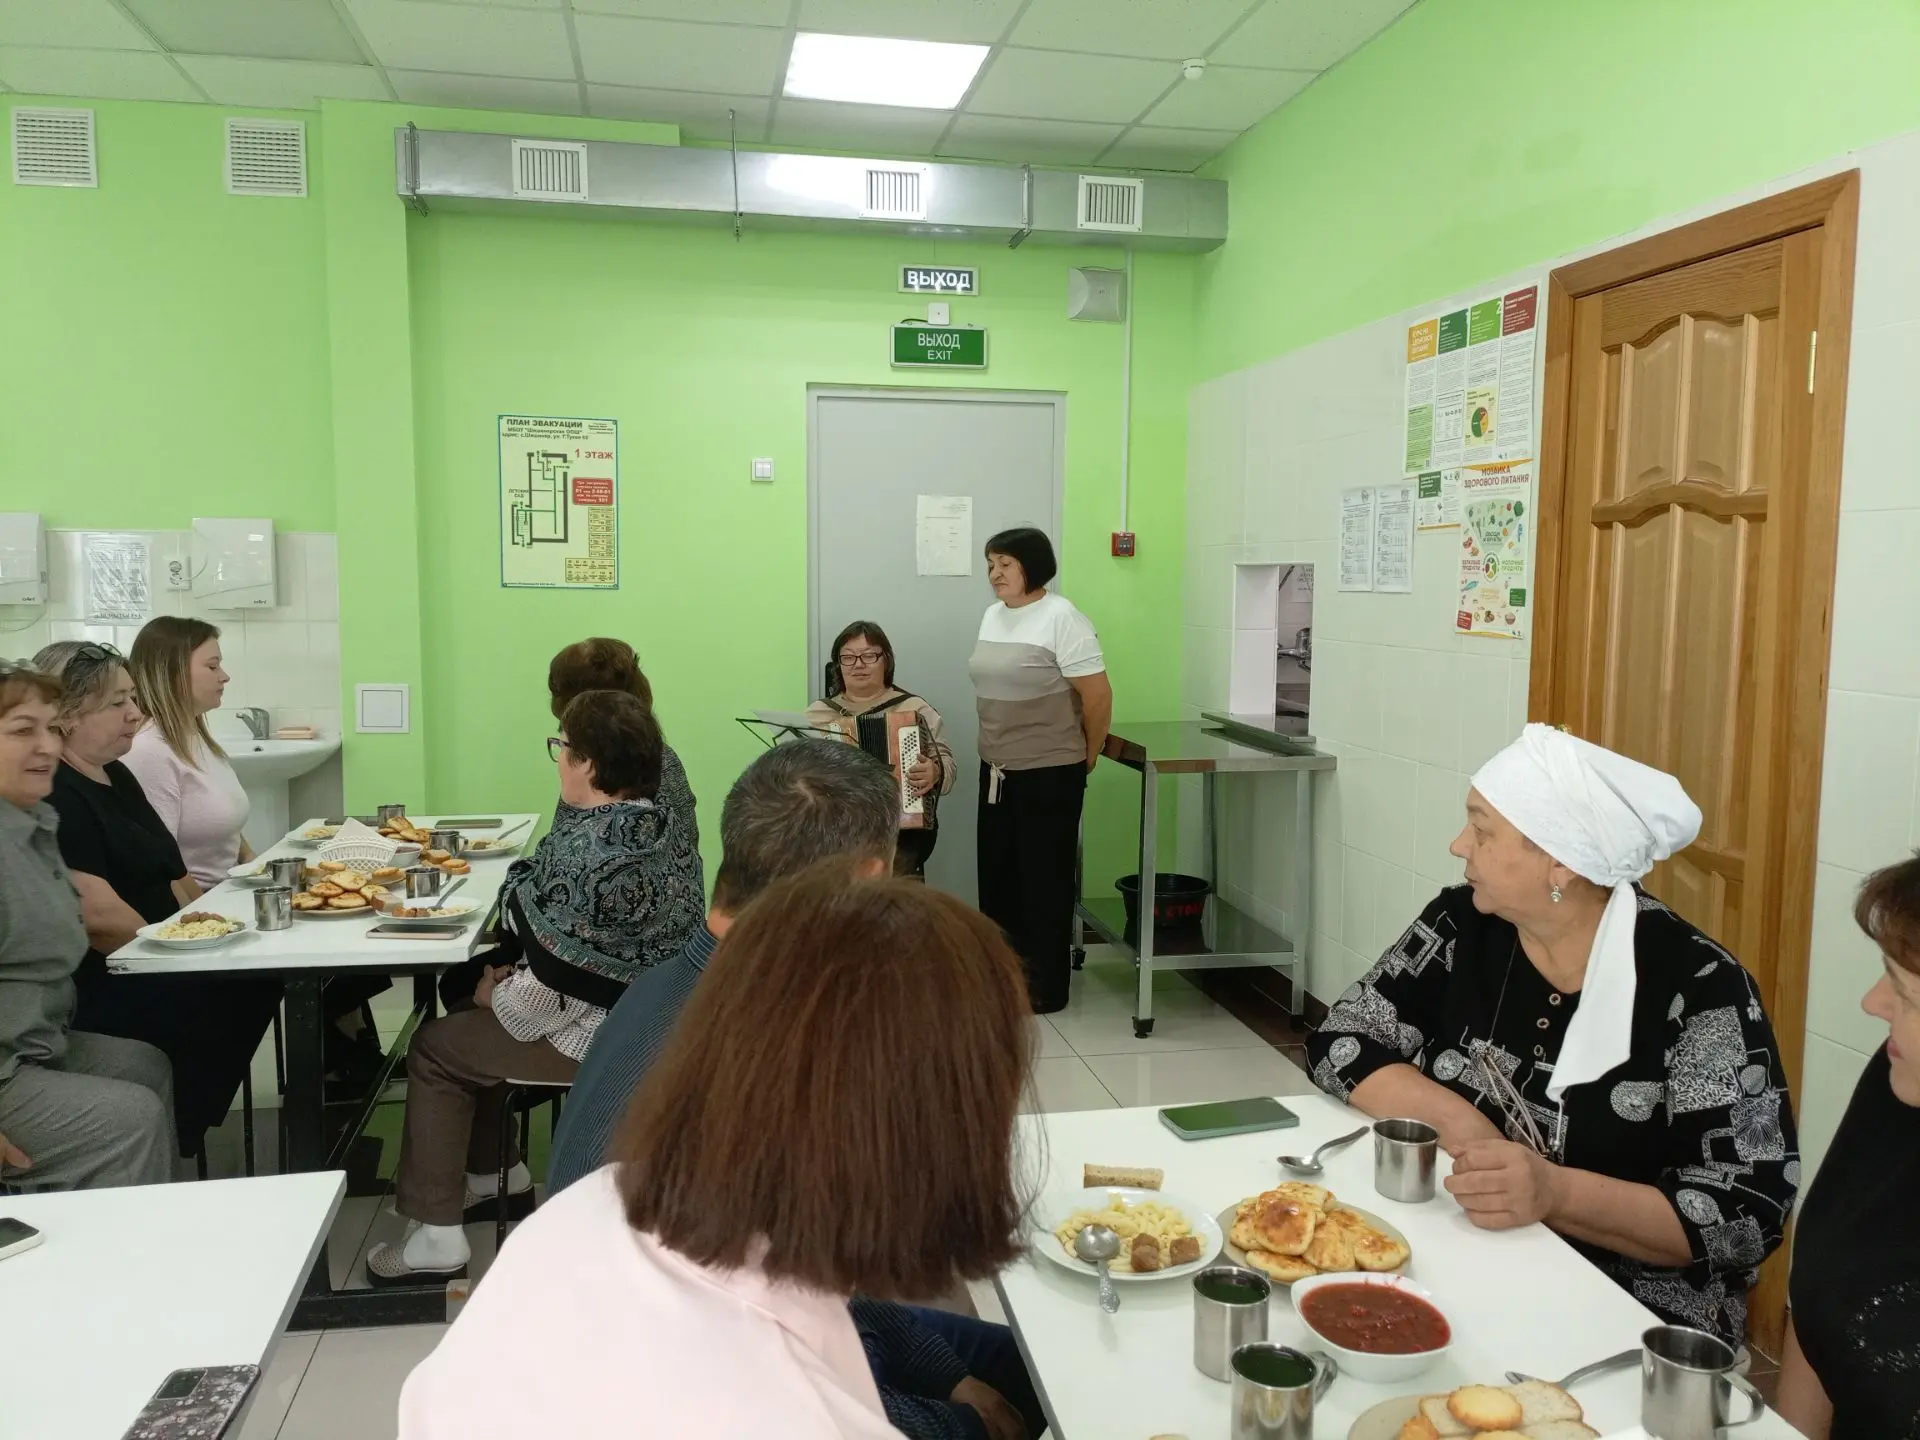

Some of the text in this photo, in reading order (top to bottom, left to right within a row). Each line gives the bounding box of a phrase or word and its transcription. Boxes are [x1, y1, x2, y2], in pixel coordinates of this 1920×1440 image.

[907, 270, 970, 288] ВЫХОД
[918, 333, 960, 350] ВЫХОД
[927, 350, 953, 360] EXIT
[506, 418, 530, 426] ПЛАН
[532, 420, 583, 428] ЭВАКУАЦИИ
[574, 448, 613, 459] 1 этаж
[1481, 465, 1511, 476] МОЗАИКА
[1464, 473, 1529, 488] ЗДОРОВОГО ПИТАНИЯ
